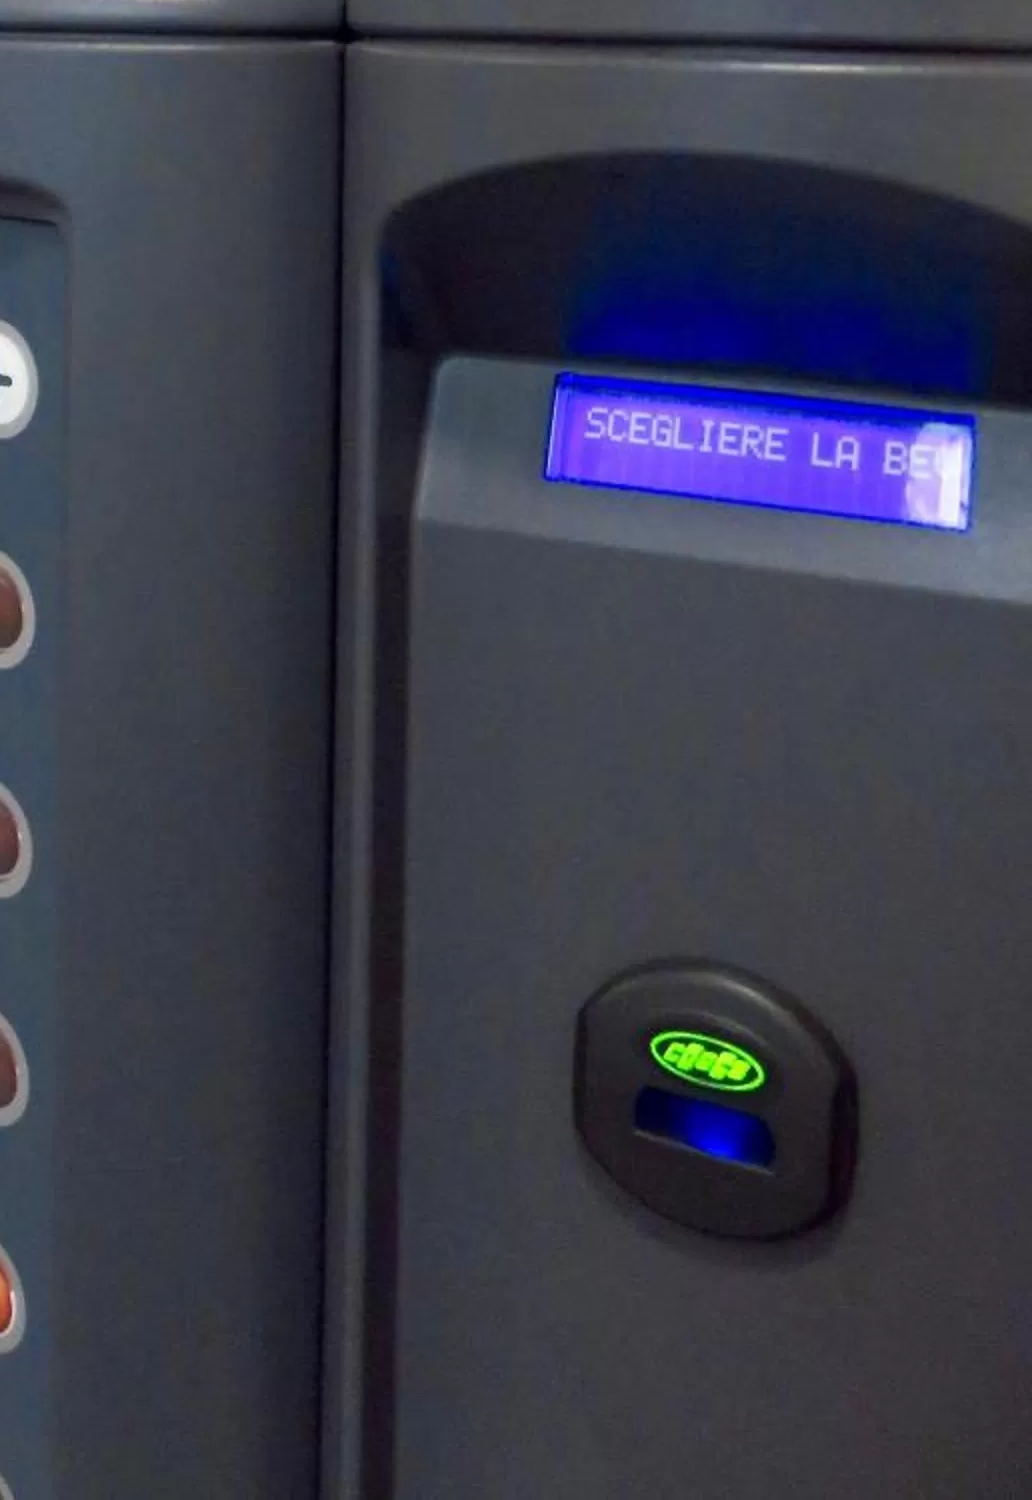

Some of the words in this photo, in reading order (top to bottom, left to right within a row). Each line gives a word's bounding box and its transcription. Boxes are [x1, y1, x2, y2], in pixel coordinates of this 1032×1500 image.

[583, 406, 790, 462] SCEGLIERE
[810, 434, 861, 470] LA
[883, 439, 946, 480] BE
